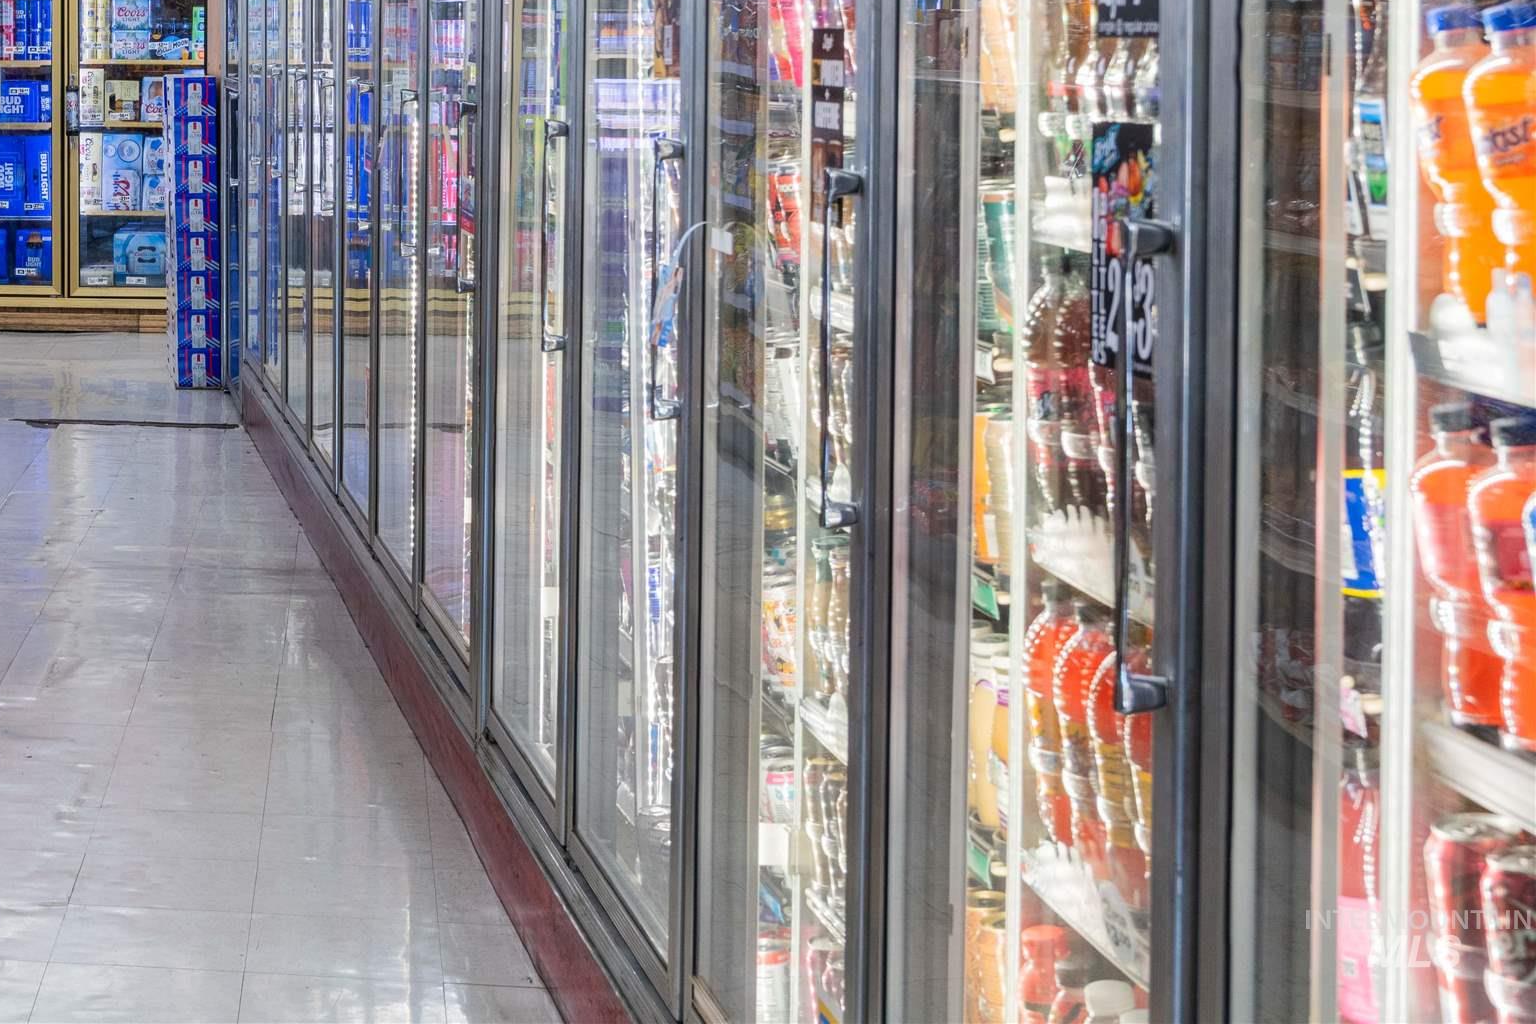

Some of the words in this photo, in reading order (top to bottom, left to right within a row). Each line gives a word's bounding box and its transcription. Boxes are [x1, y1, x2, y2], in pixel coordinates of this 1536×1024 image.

[117, 7, 146, 17] Coors
[172, 38, 190, 49] MOON
[0, 96, 22, 105] BUD
[145, 103, 163, 114] Coo
[5, 162, 14, 191] LIGHT
[40, 173, 49, 201] LIGHT
